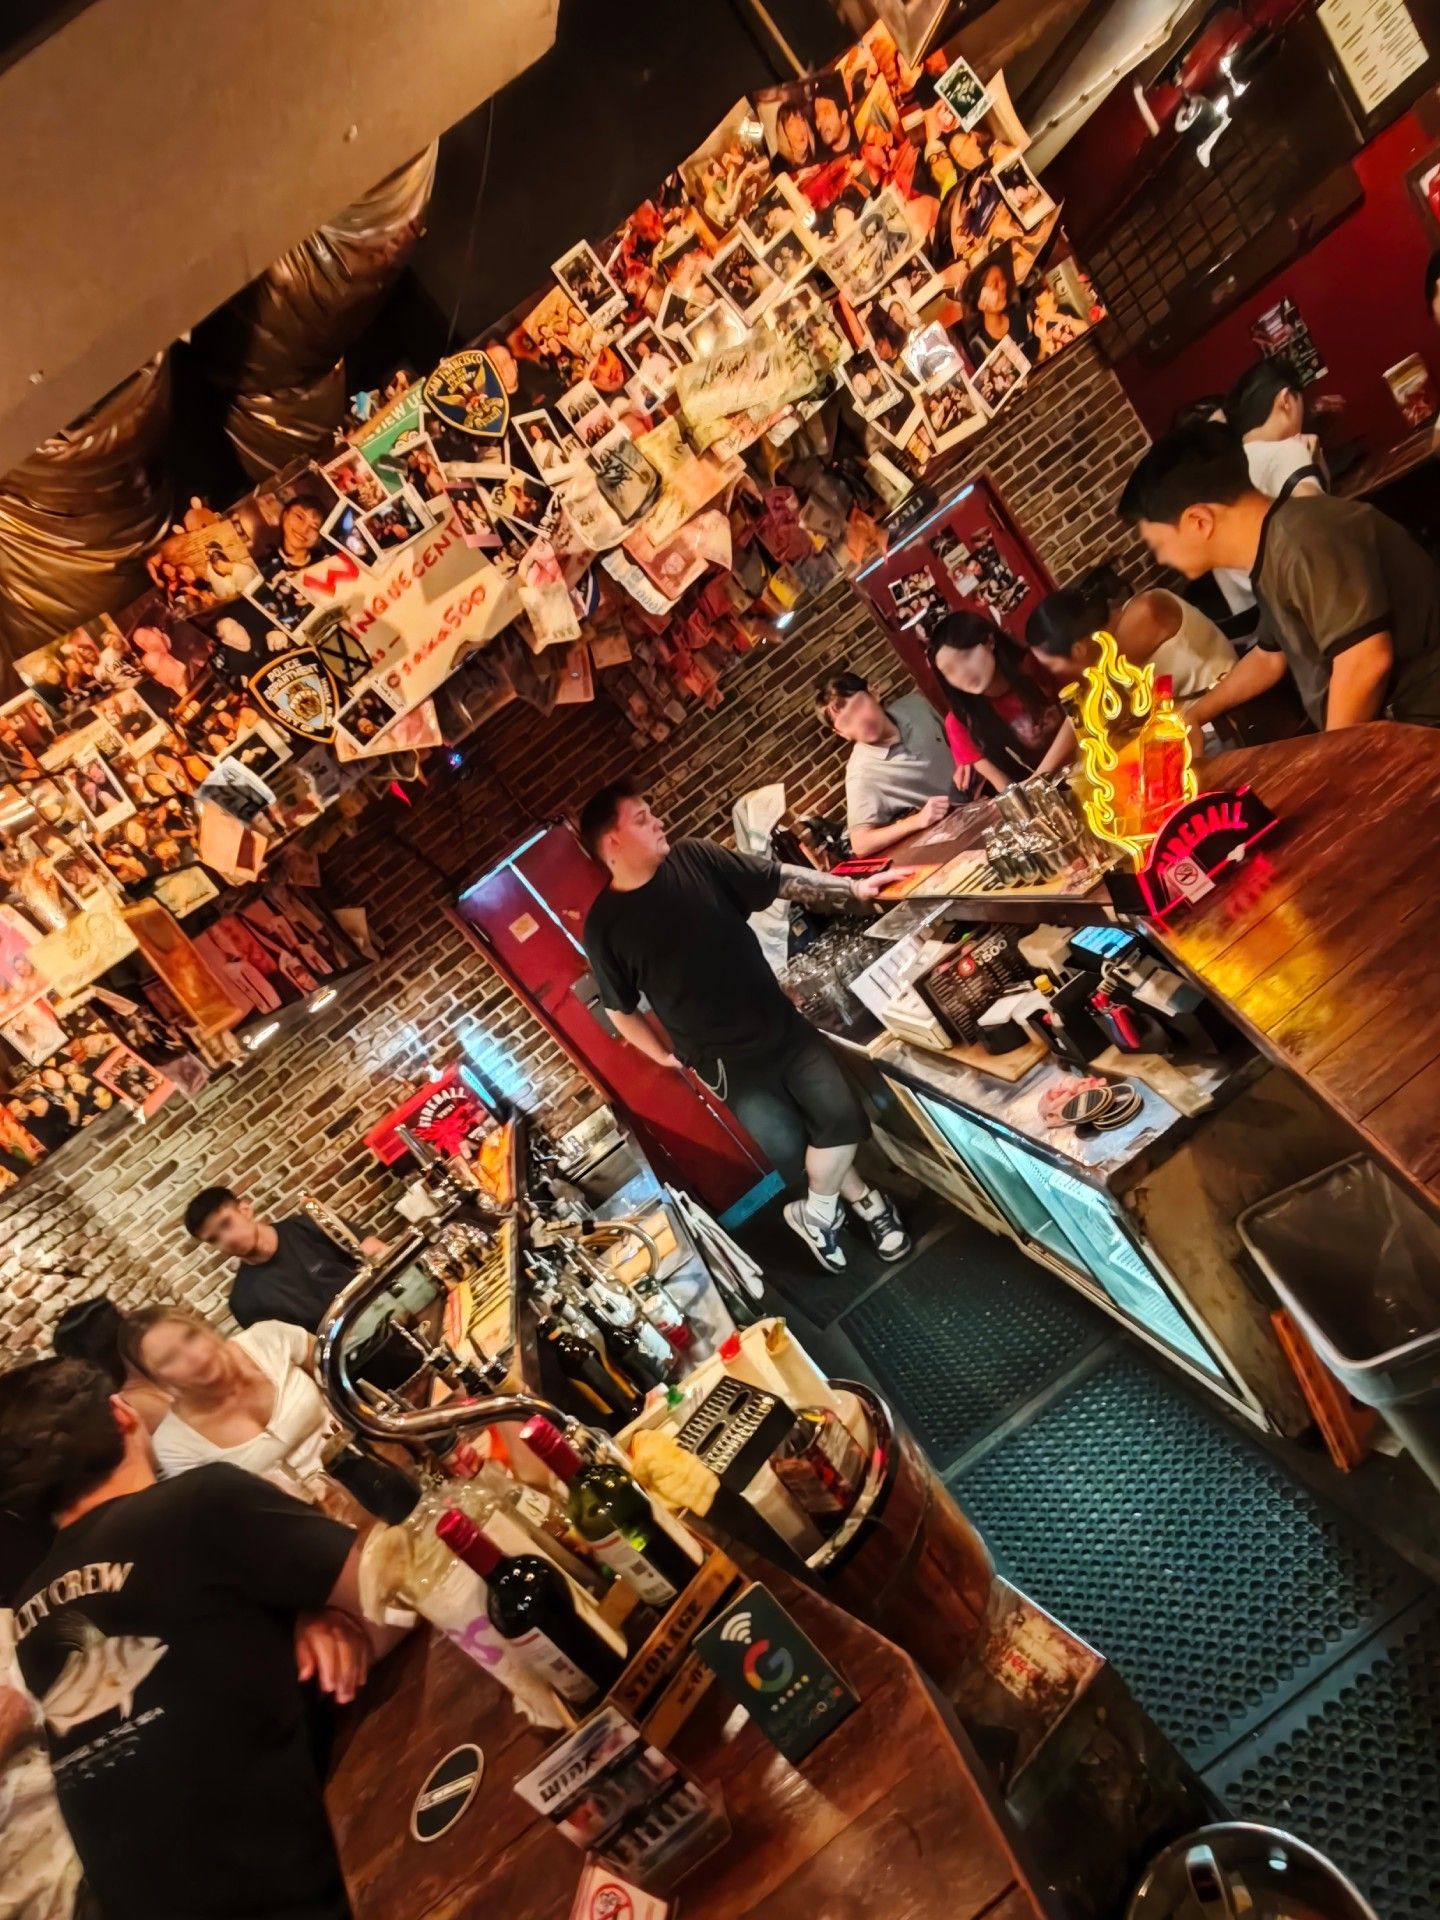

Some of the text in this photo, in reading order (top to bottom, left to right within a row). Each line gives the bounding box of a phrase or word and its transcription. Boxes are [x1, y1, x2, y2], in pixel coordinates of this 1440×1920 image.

[263, 662, 318, 701] DEPARTMENT
[266, 656, 301, 681] POLICE
[1158, 802, 1247, 869] FIREBALL
[418, 1086, 468, 1126] FIREBALL
[48, 1562, 133, 1605] CREW
[624, 1600, 702, 1699] STORAGE
